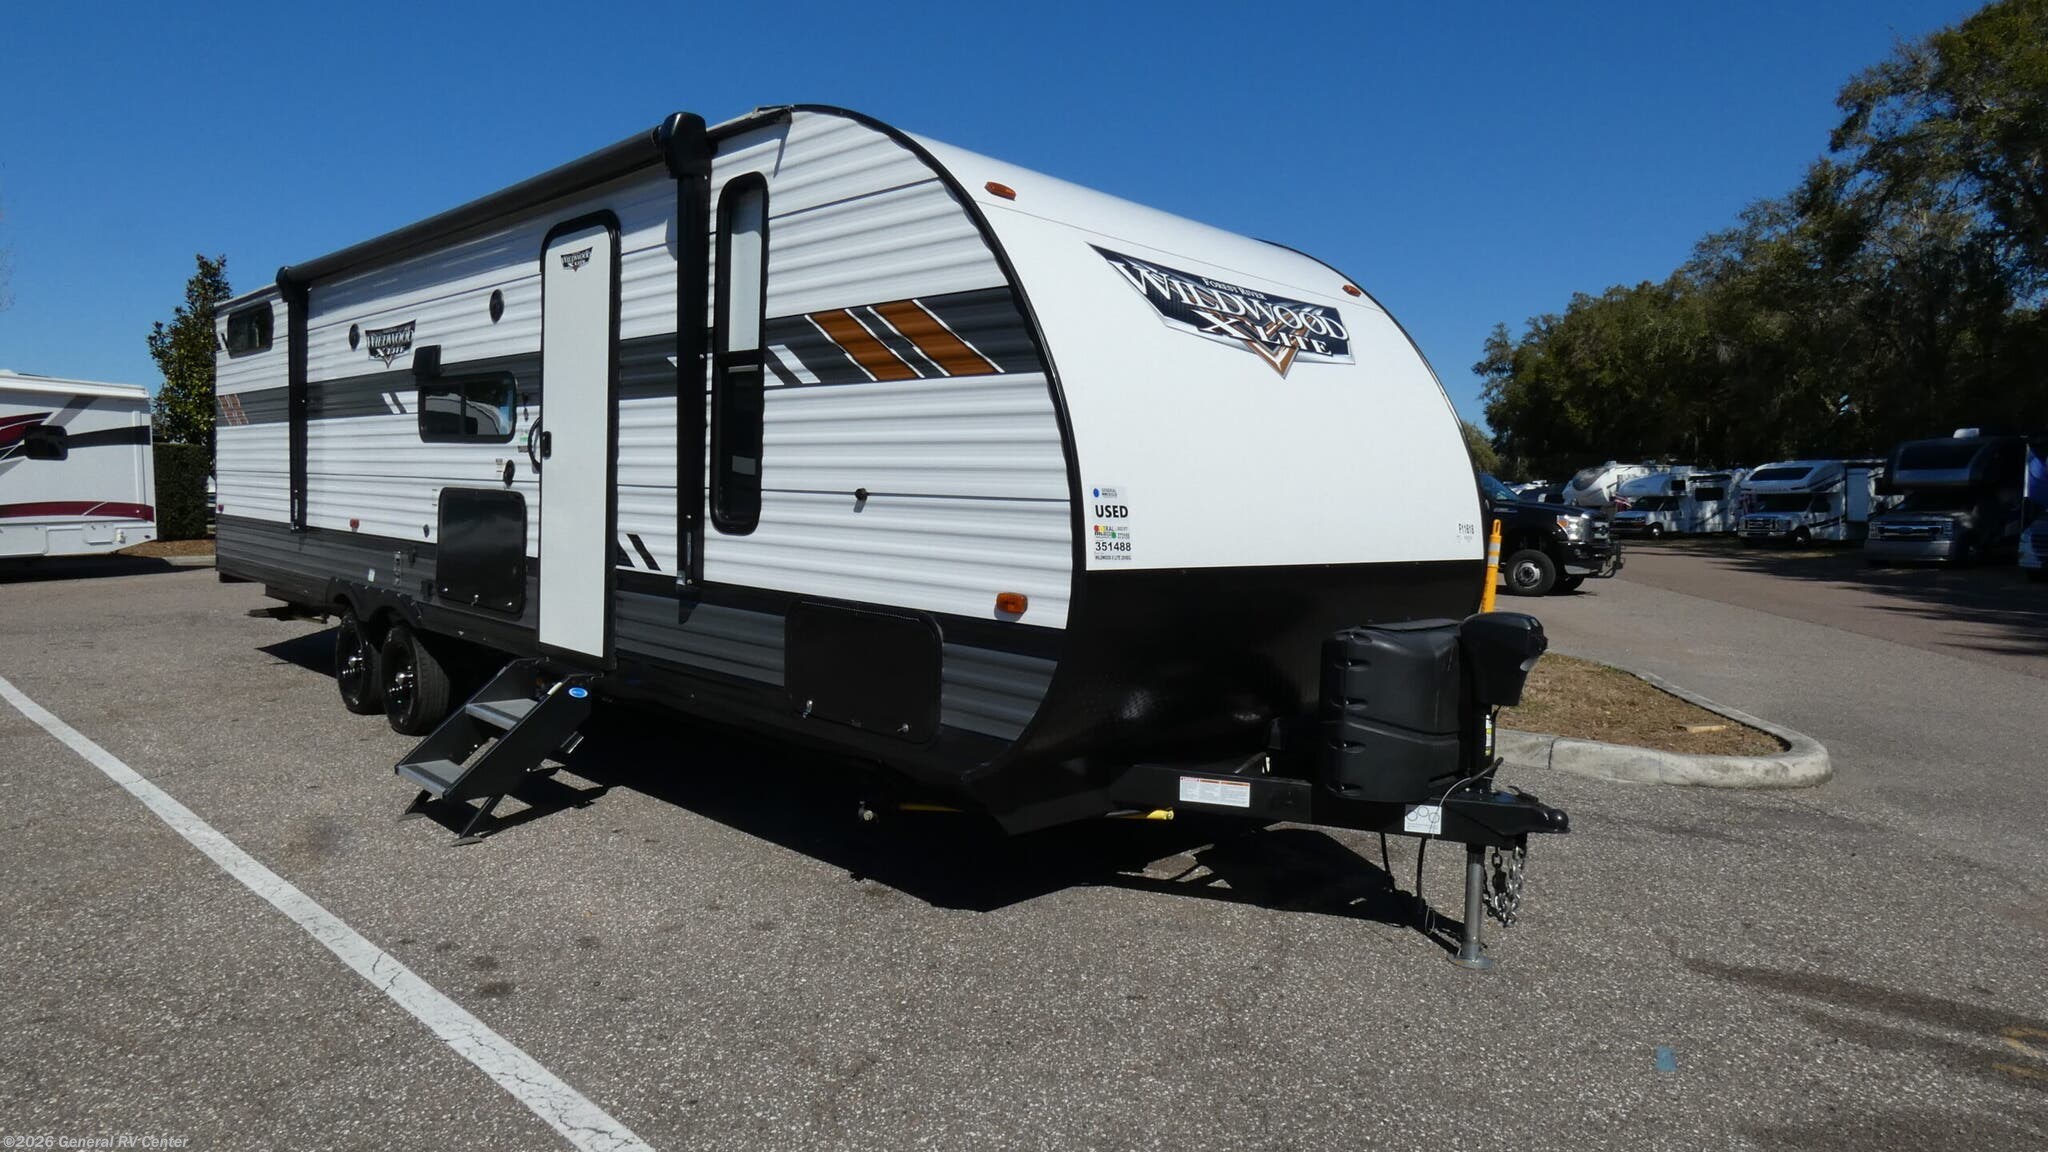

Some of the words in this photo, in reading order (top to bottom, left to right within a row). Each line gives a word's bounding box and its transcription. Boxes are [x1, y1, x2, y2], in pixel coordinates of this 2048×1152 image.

[1202, 277, 1240, 295] FOREST
[1240, 287, 1268, 301] RIVER
[1107, 259, 1350, 341] WILDWOOD
[1095, 504, 1129, 518] USED
[1095, 541, 1132, 552] 351488
